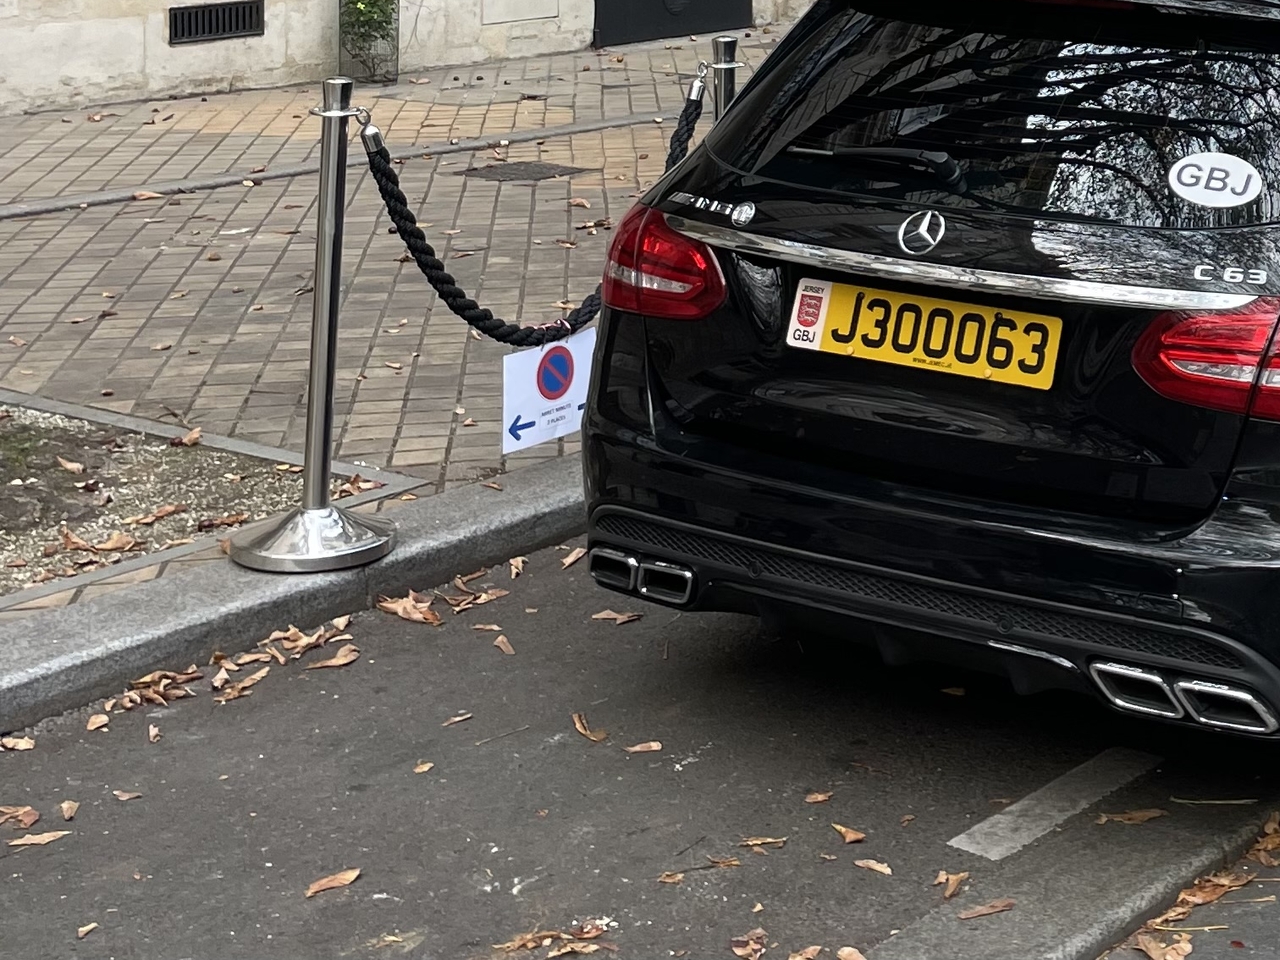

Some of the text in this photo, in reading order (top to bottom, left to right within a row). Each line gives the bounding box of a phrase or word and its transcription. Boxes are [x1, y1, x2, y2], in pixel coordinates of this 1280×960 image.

[1176, 163, 1253, 197] GBJ
[1194, 265, 1268, 285] C 63
[802, 285, 825, 294] JERSEY
[793, 328, 816, 343] GBJ
[831, 292, 1050, 375] J300063
